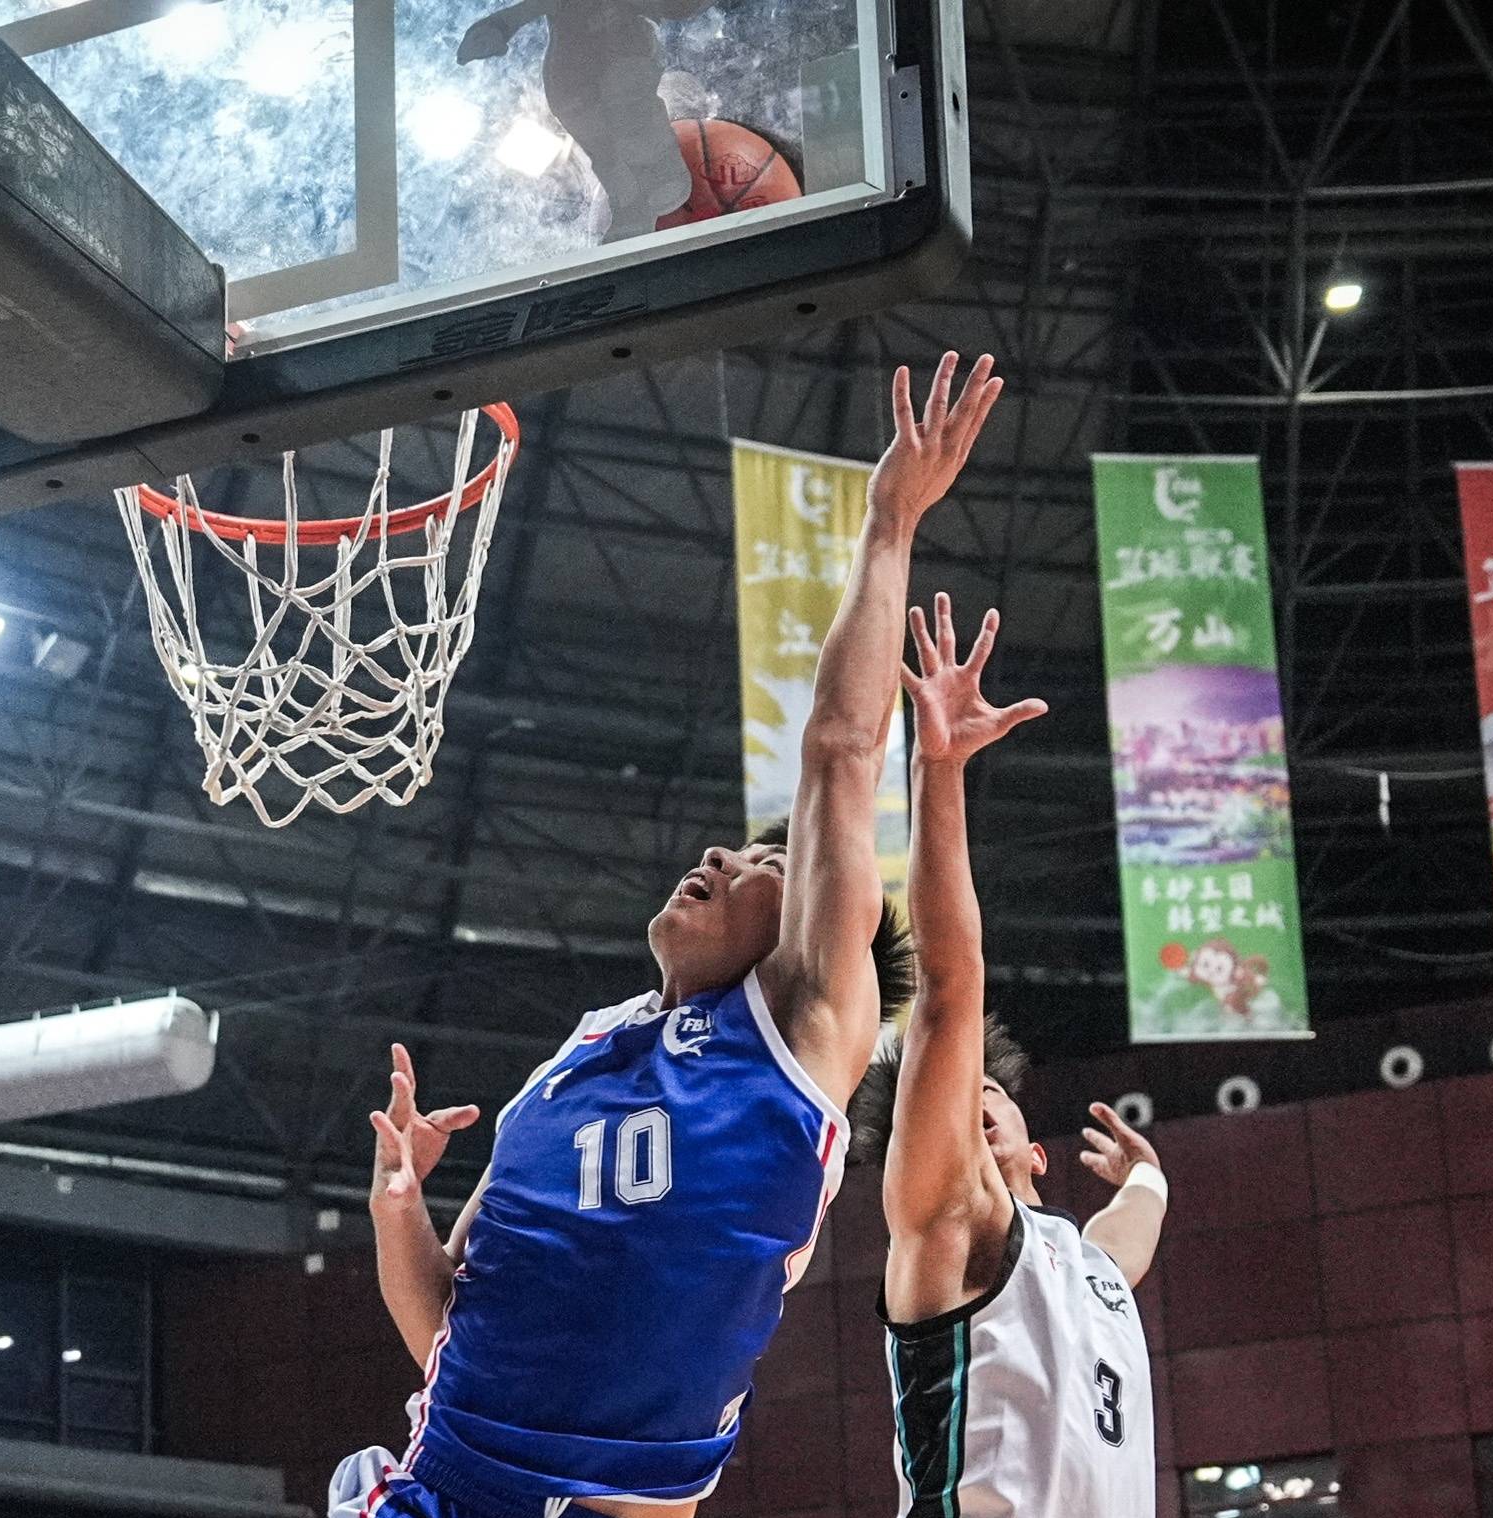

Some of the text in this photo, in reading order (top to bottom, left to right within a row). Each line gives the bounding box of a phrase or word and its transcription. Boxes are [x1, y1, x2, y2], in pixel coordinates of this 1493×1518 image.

[1146, 607, 1235, 655] 万山
[573, 1107, 673, 1210] 10
[1101, 1280, 1123, 1293] FBA
[1094, 1358, 1126, 1448] 3
